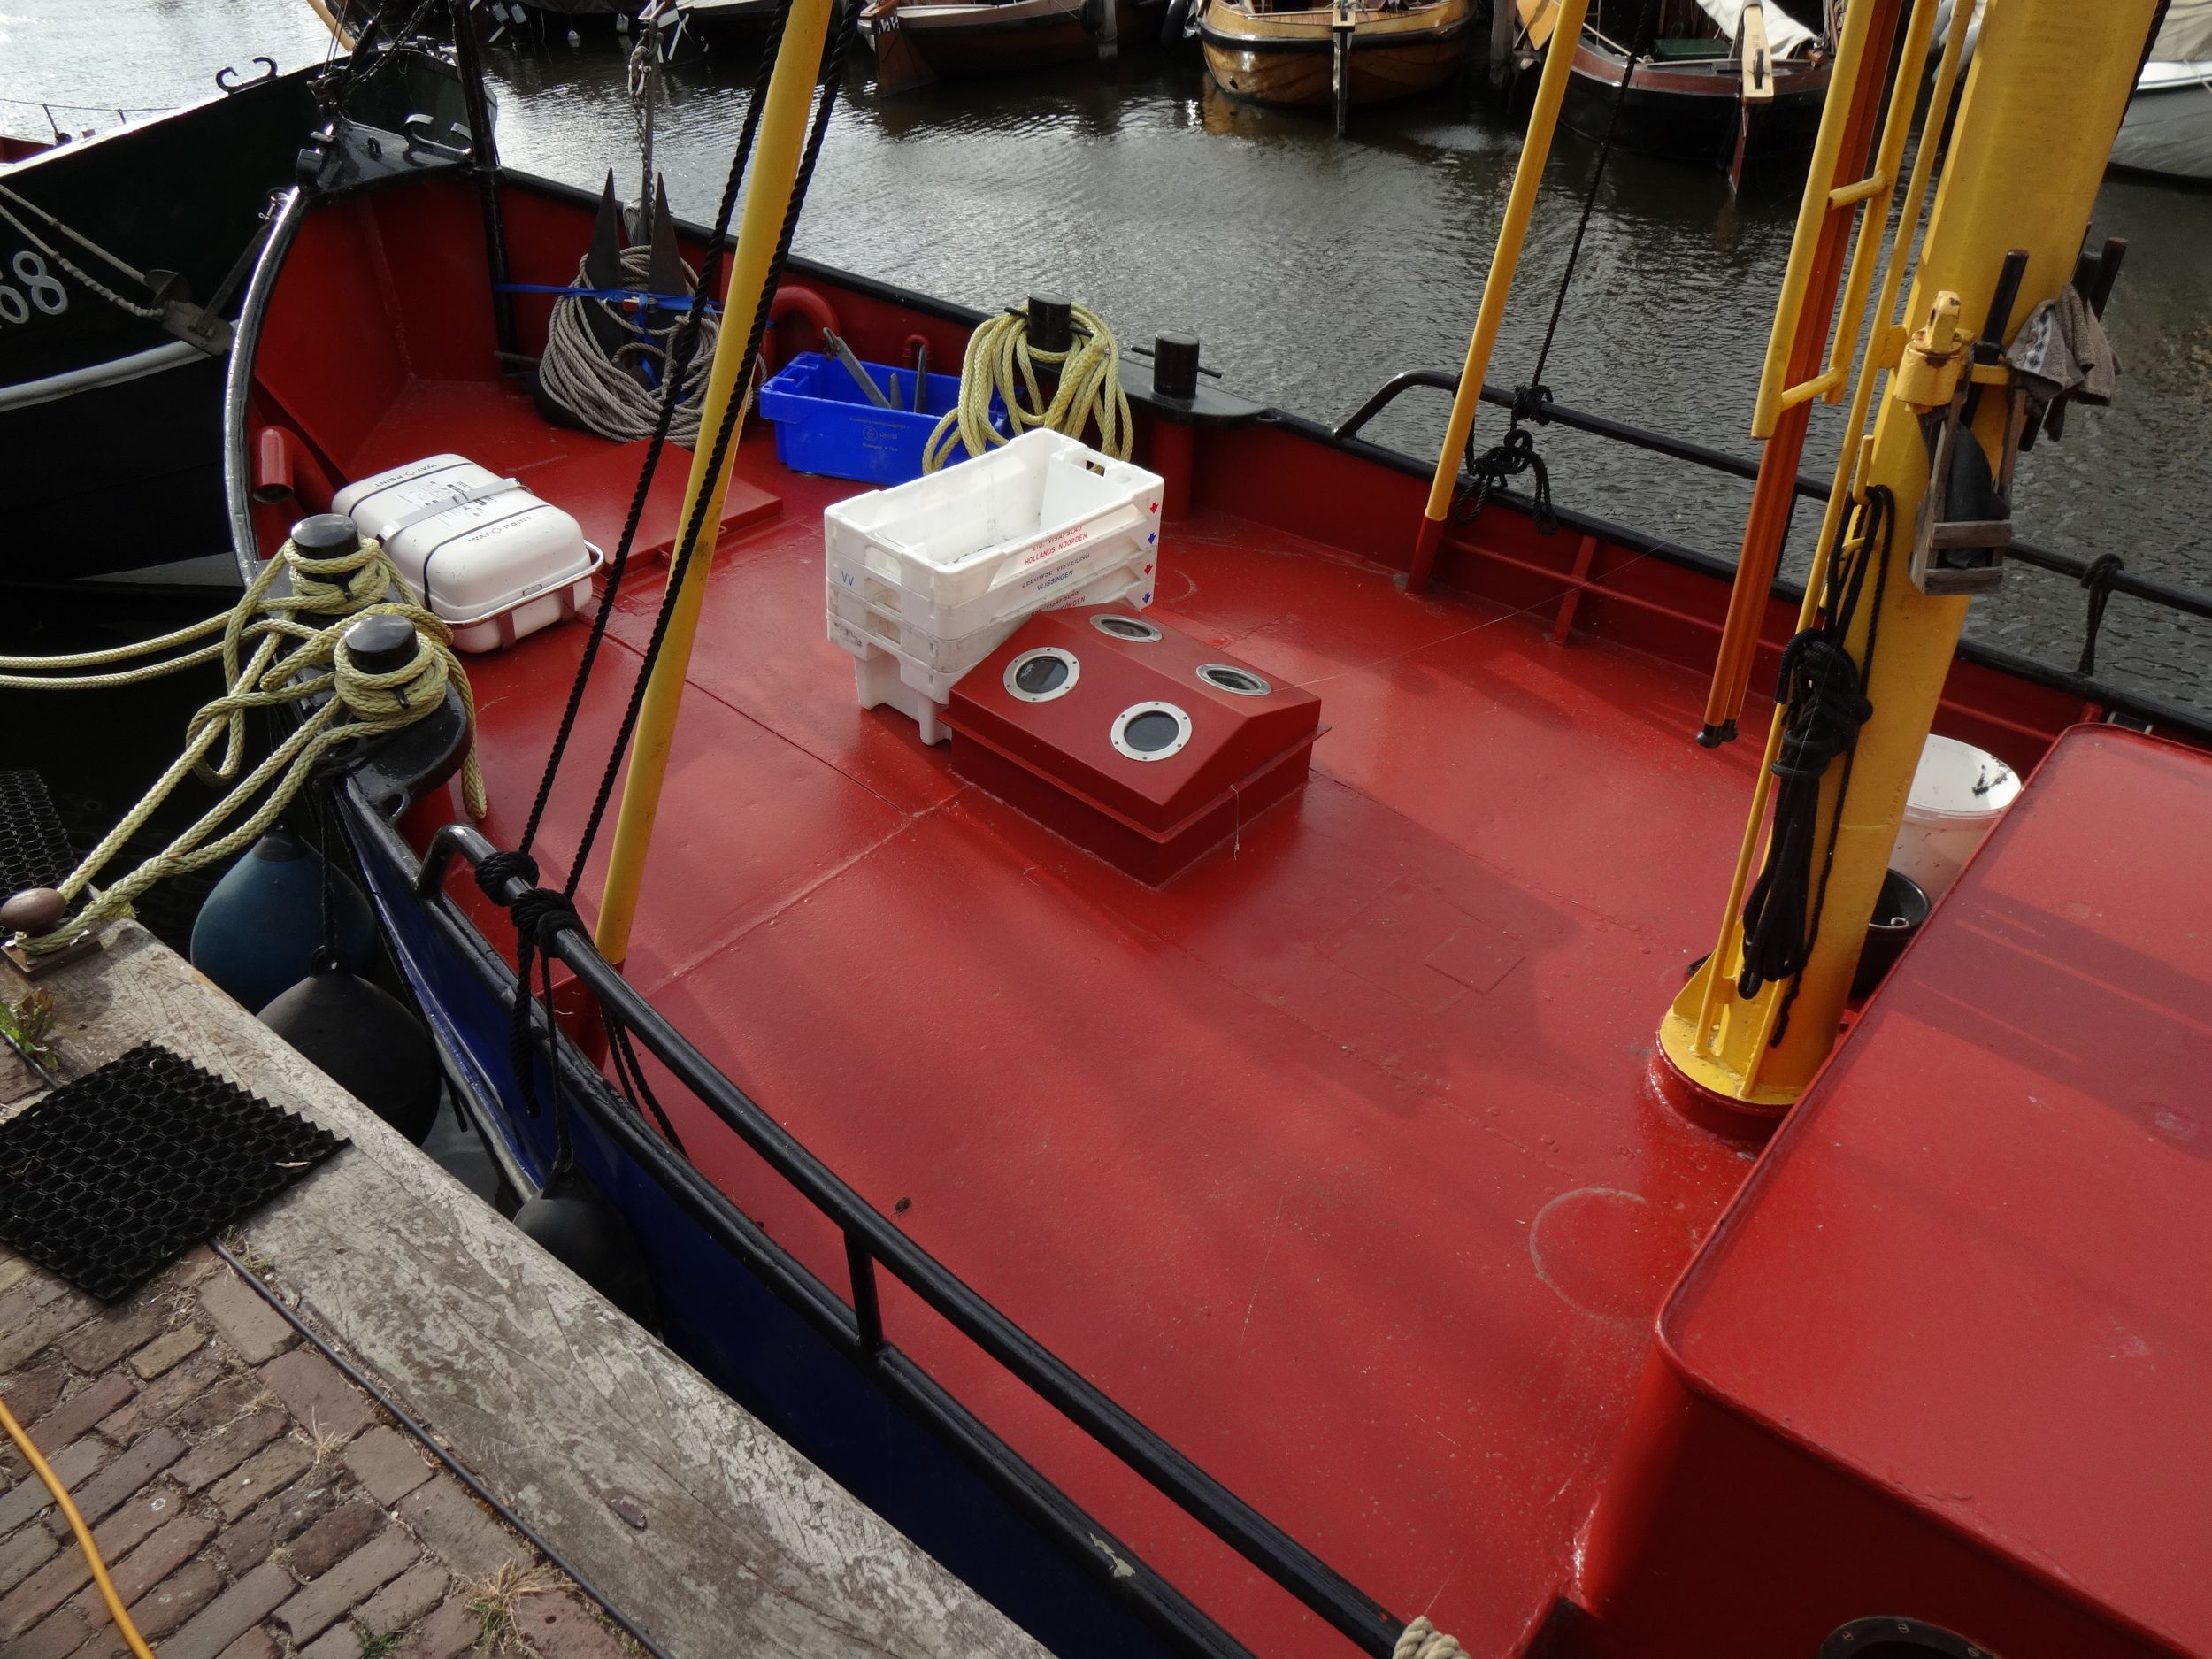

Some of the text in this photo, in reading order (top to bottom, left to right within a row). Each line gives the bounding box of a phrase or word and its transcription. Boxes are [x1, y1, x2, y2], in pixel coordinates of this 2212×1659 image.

[468, 516, 532, 542] WAY POINT
[1025, 532, 1088, 565] HOLLANDS NOORDEN
[1036, 570, 1074, 591] VLISSINGEN
